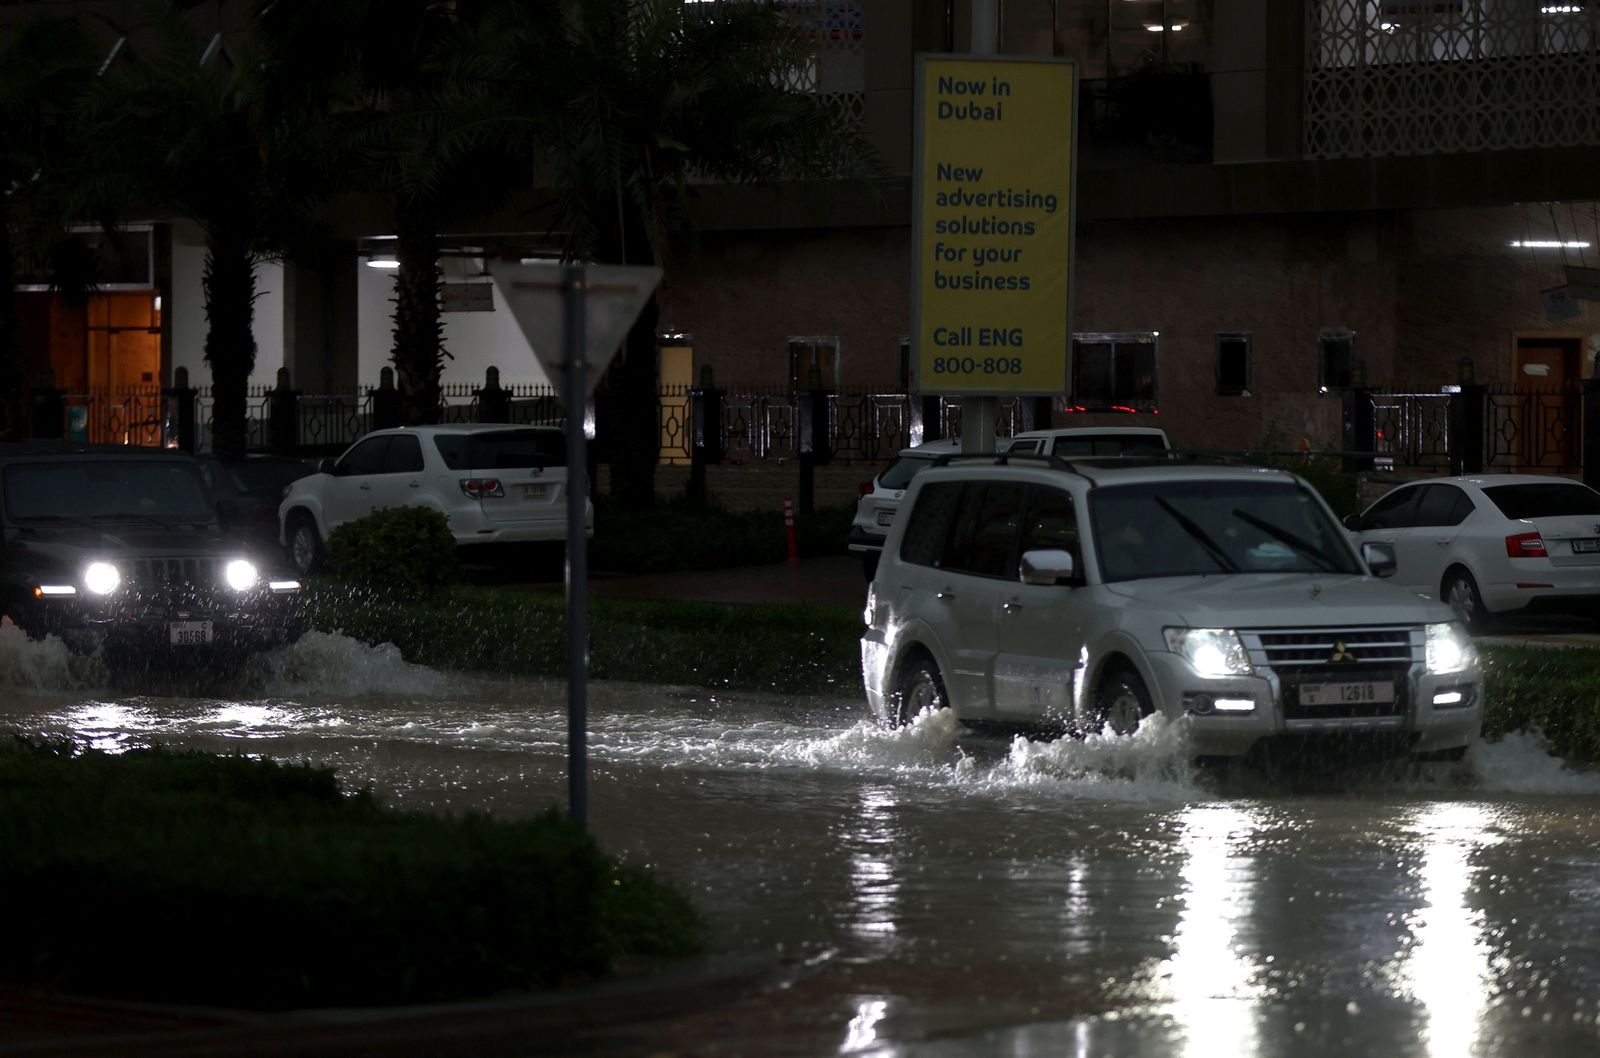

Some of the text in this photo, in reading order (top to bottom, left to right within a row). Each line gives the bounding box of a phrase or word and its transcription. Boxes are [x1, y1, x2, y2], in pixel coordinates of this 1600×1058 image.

[938, 76, 1010, 96] Now in
[938, 101, 1002, 121] Dubai
[936, 163, 984, 182] New
[936, 189, 1057, 213] advertising
[935, 216, 1035, 236] solutions
[935, 243, 1023, 266] for your
[934, 270, 1030, 290] business
[933, 327, 1023, 347] Call ENG
[933, 357, 1022, 374] 800-808
